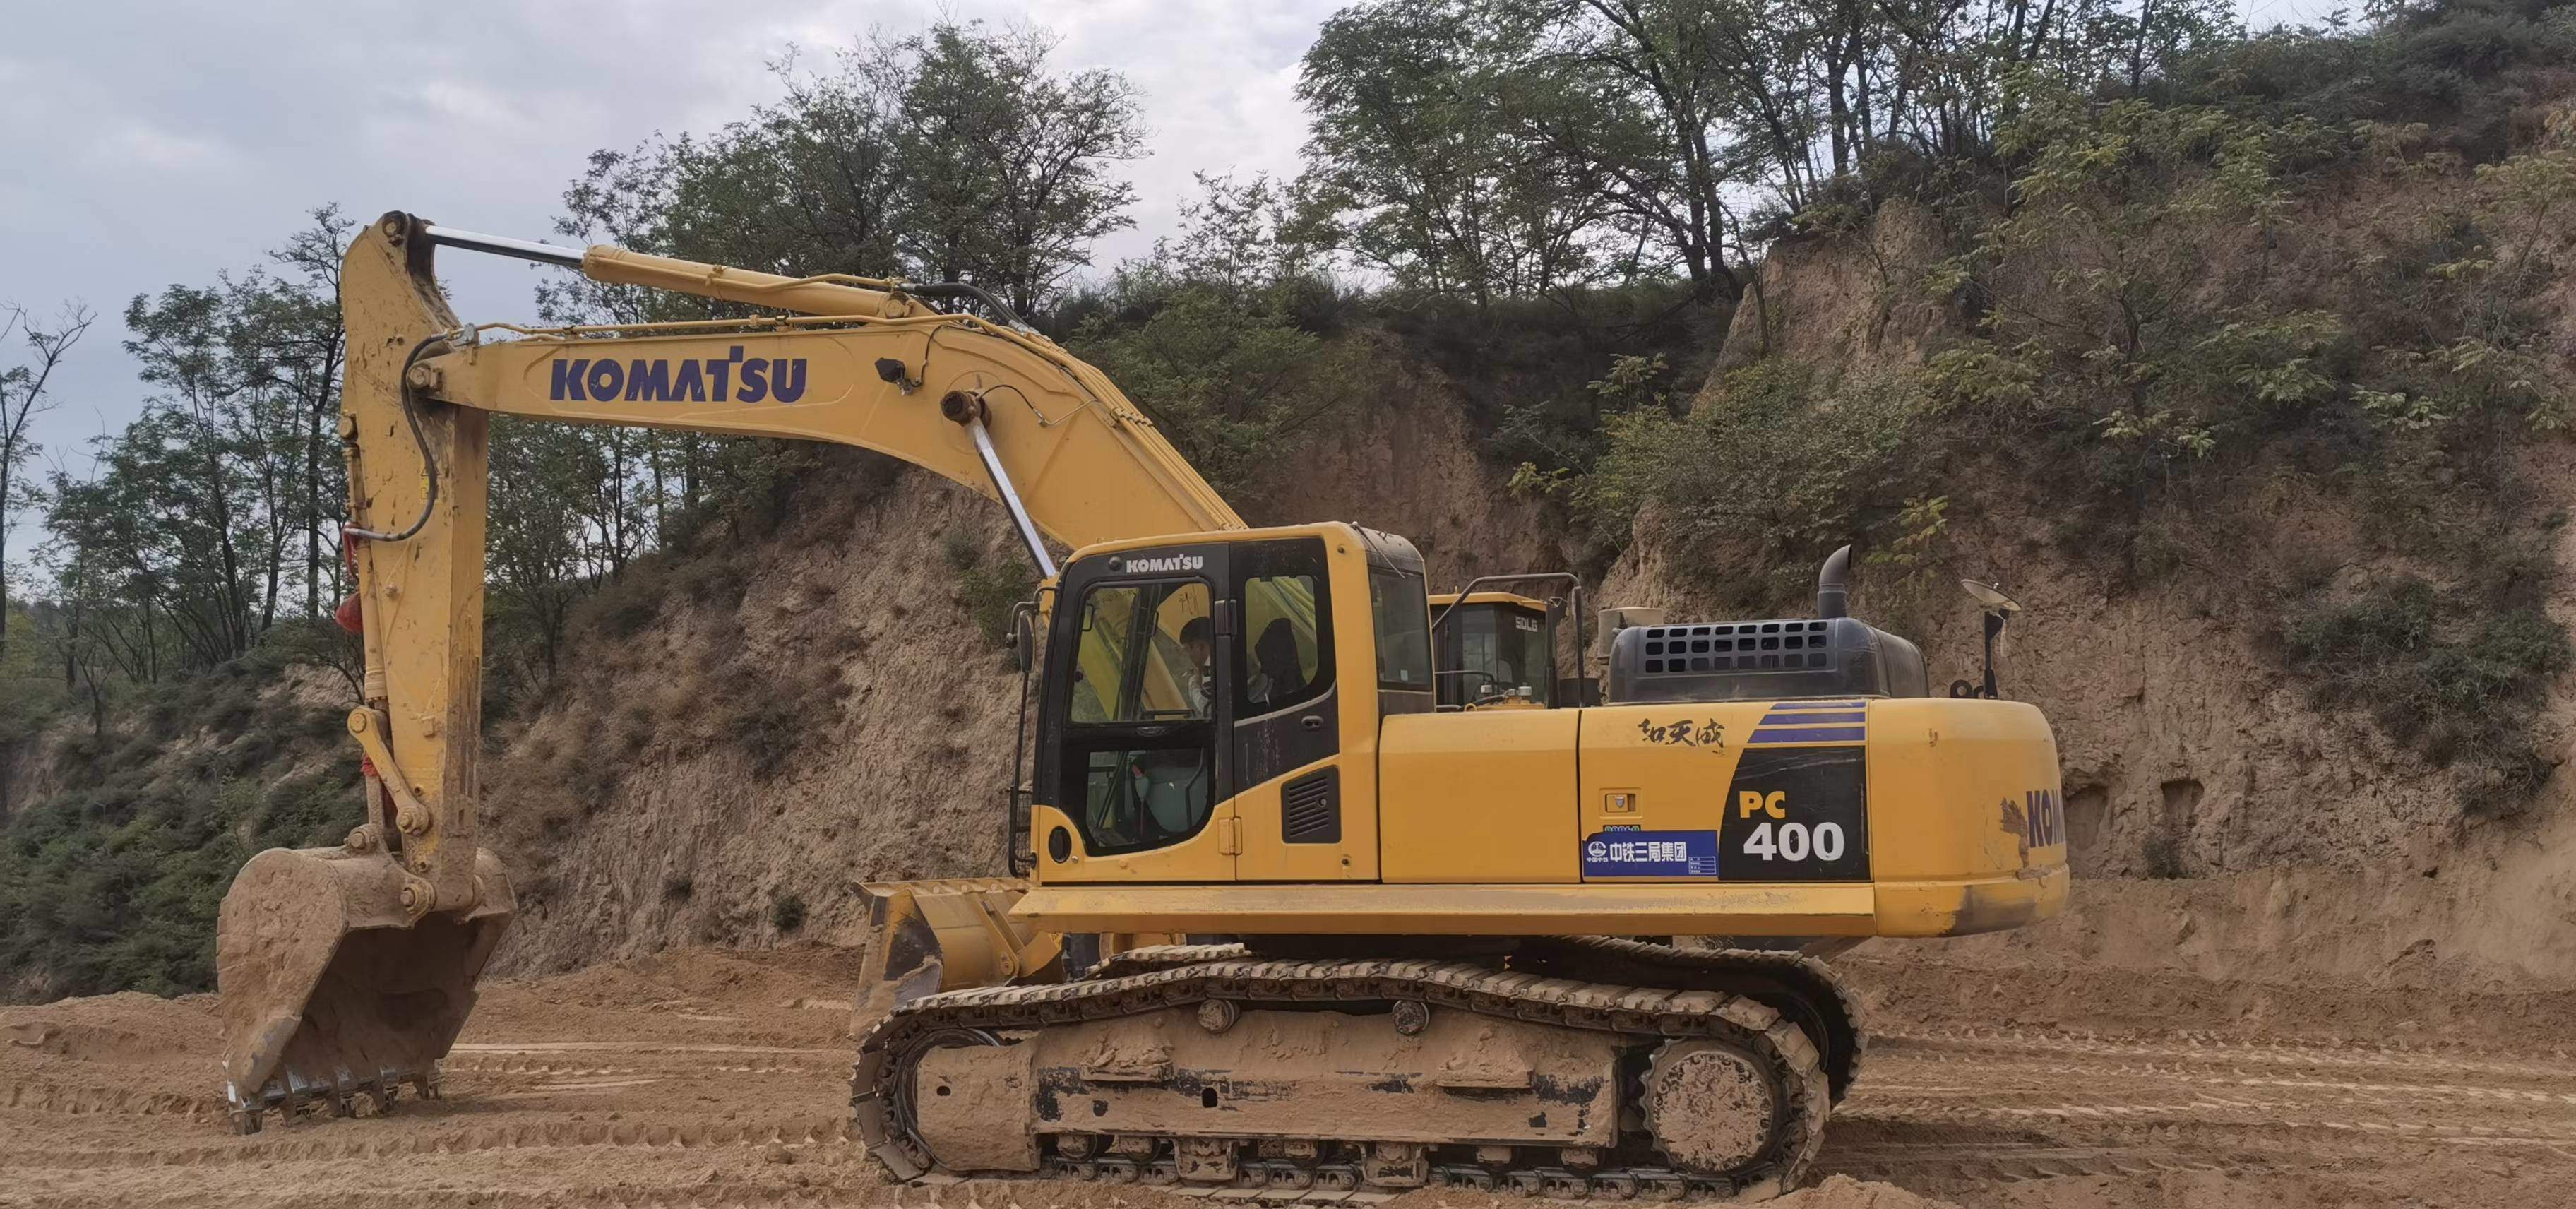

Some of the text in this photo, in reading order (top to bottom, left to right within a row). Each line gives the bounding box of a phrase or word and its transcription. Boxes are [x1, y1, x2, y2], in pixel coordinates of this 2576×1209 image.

[549, 345, 807, 403] KOMATSU
[1126, 554, 1203, 573] KOMATSU
[1515, 616, 1537, 632] SDLG
[1739, 791, 1785, 819] PC
[1609, 842, 1687, 862] 中铁三局集团
[1743, 821, 1844, 862] 400
